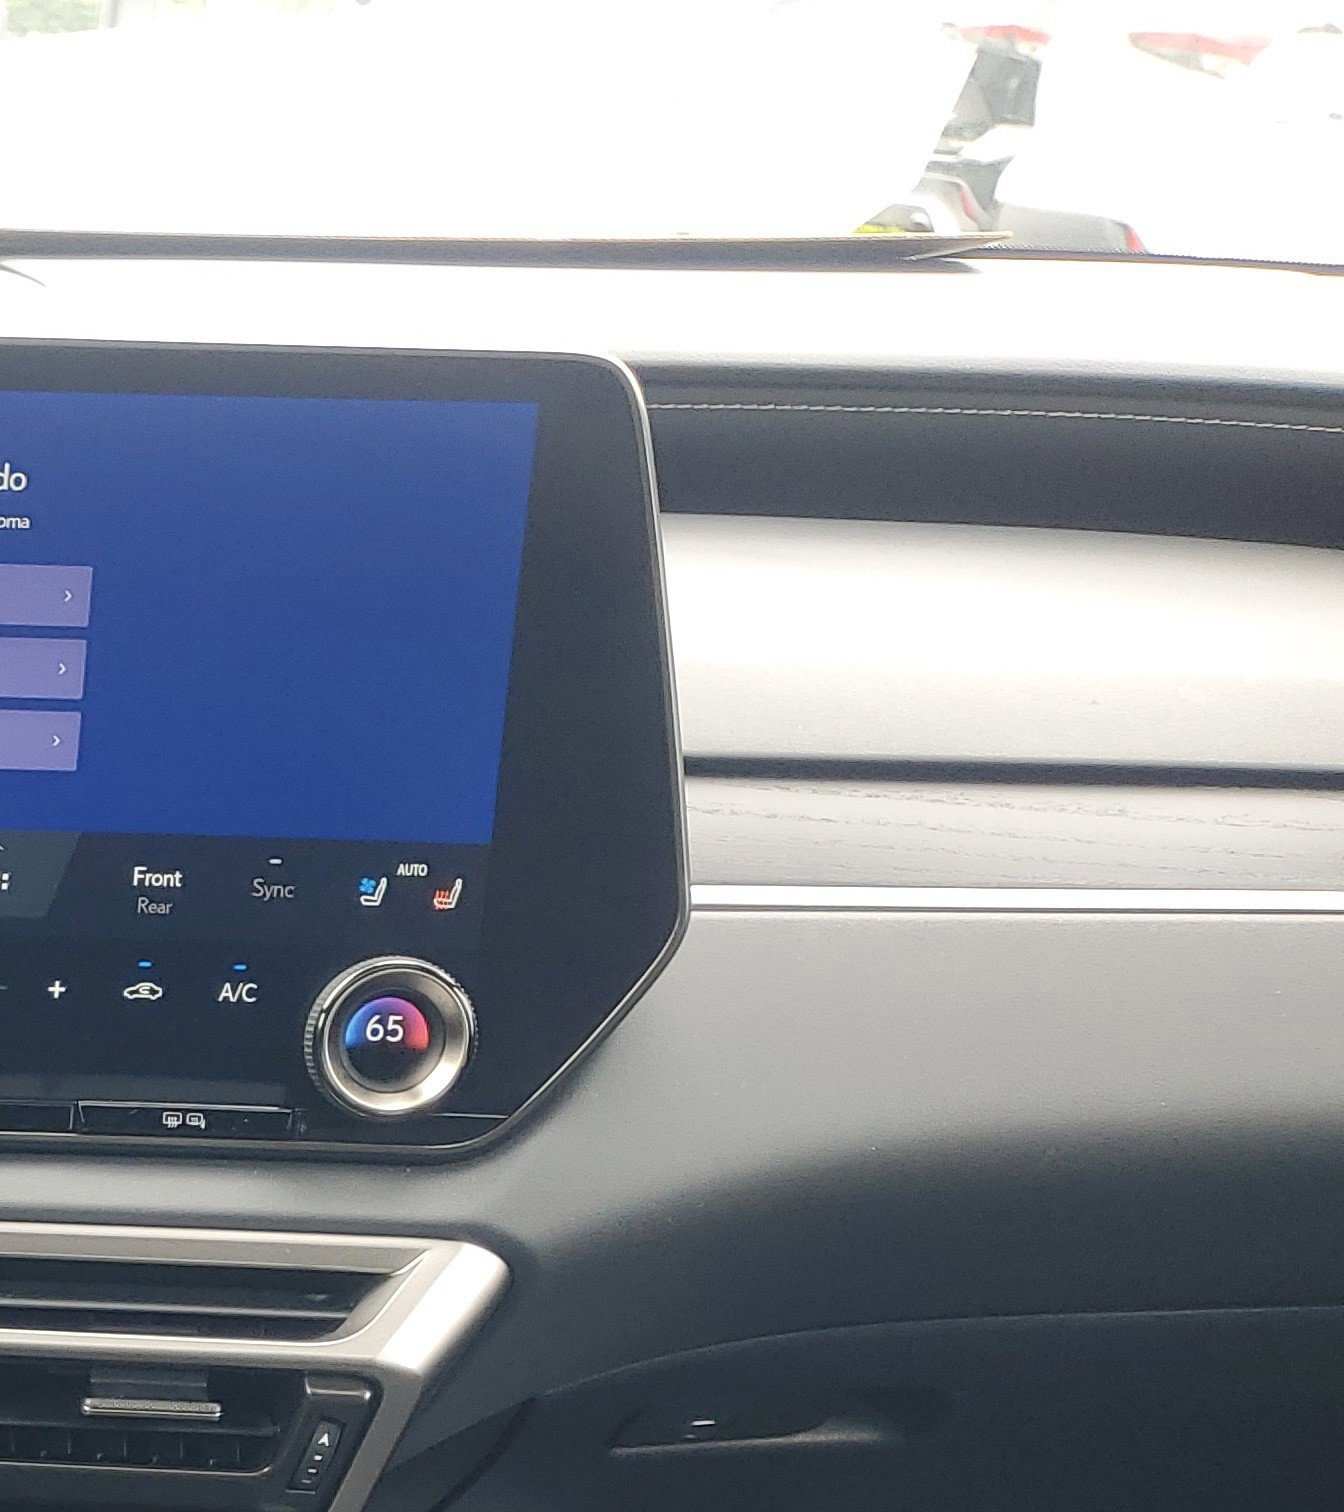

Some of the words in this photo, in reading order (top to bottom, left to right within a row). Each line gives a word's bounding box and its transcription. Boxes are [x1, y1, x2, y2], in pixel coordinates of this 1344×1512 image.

[132, 867, 183, 888] Front
[397, 863, 428, 877] AUTO
[251, 878, 296, 901] Sync
[137, 897, 173, 916] Rear
[218, 982, 258, 1004] A/C
[365, 1016, 405, 1043] 65
